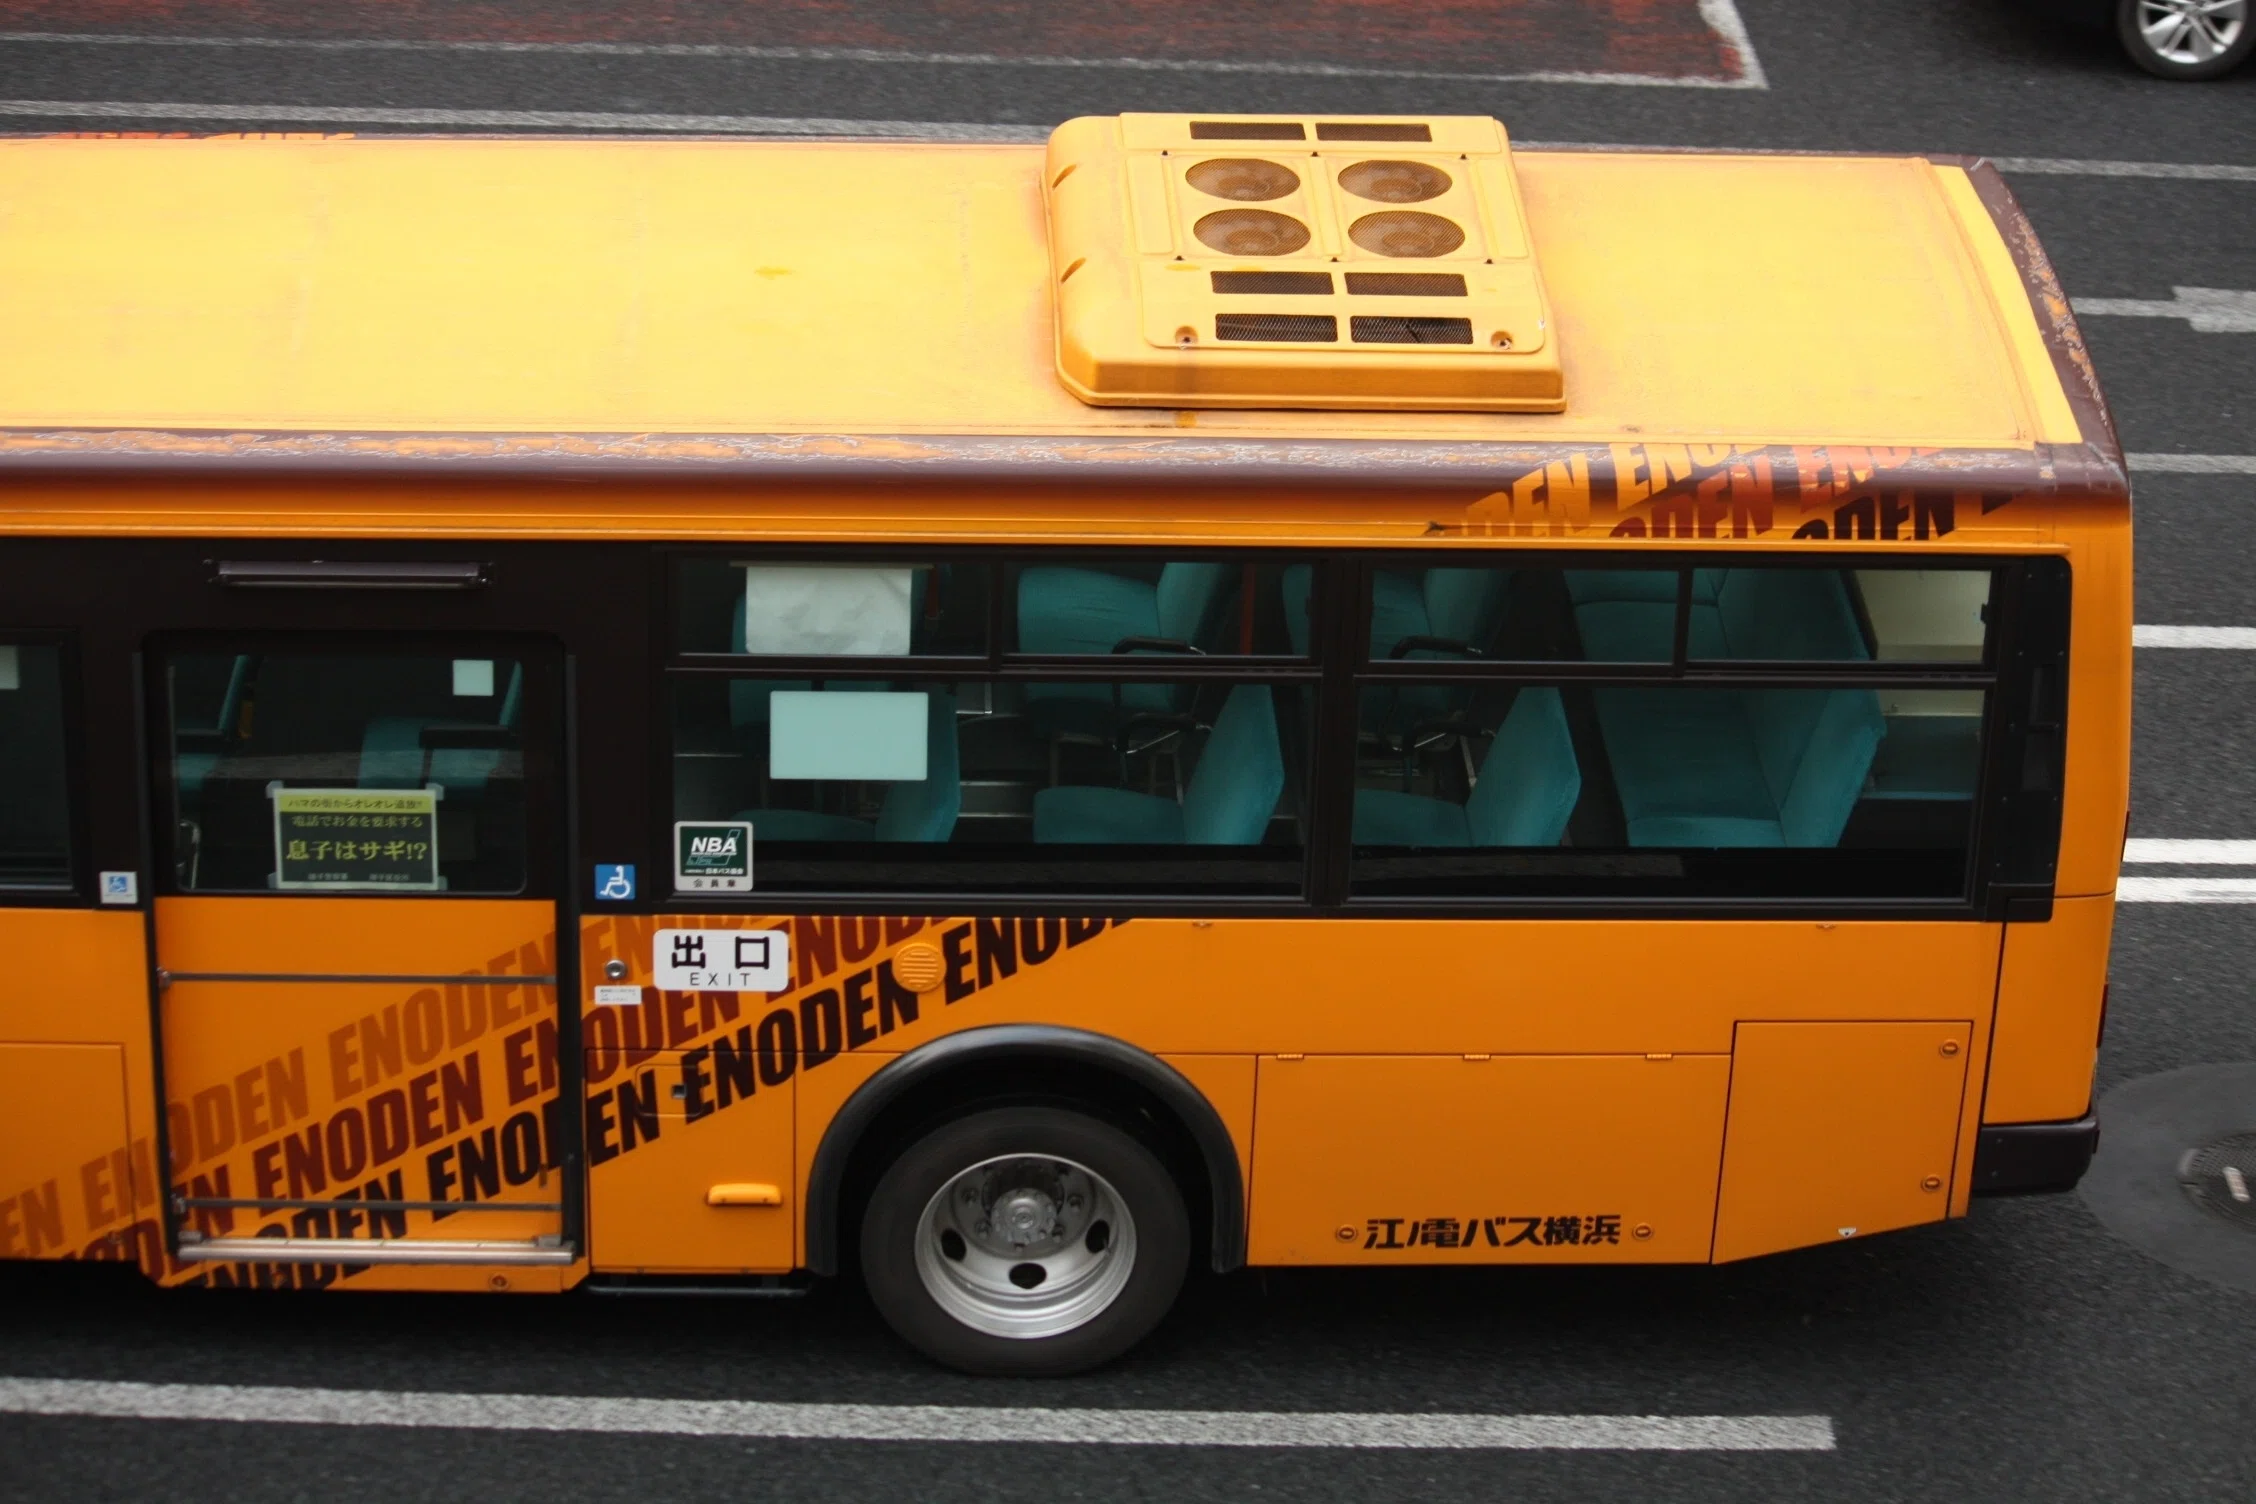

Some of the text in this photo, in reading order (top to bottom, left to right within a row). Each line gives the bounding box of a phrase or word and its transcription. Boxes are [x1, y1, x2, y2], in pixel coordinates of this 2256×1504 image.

[691, 837, 737, 852] NBA
[671, 934, 770, 971] 出口
[689, 972, 752, 986] EXIT
[328, 930, 558, 1103] ENODEN
[681, 953, 920, 1123] ENODEN
[253, 1050, 483, 1218] ENODEN
[1363, 1214, 1622, 1250] 江ノ電バス横浜
